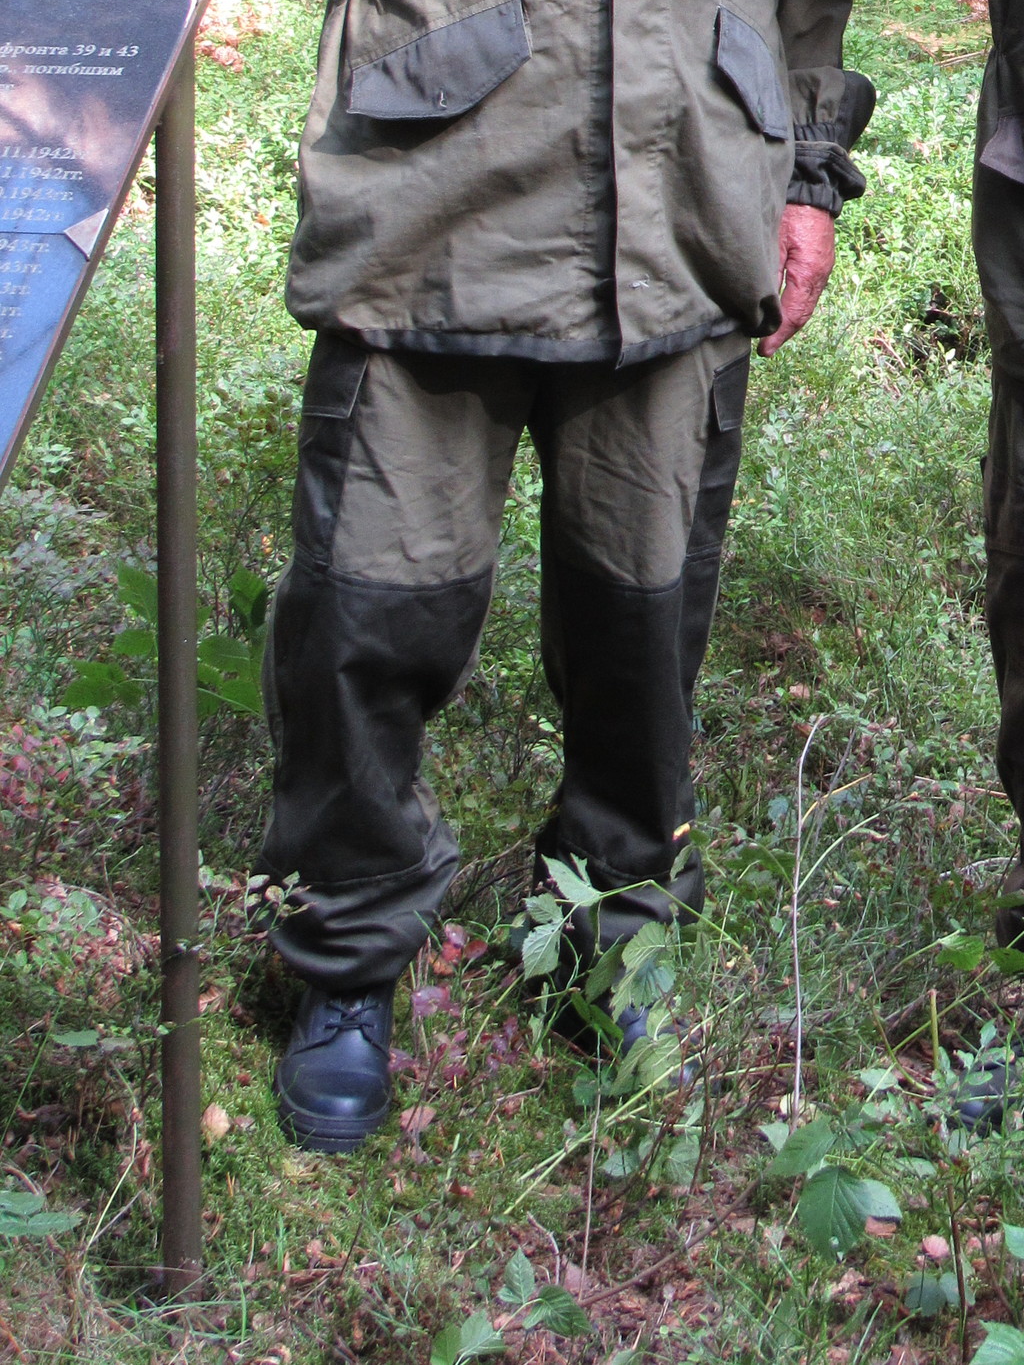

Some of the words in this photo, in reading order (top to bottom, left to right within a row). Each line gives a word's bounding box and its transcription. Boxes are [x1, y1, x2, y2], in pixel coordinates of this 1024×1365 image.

[0, 41, 69, 58] фронта
[72, 44, 97, 56] 39
[98, 47, 113, 57] и
[116, 44, 140, 57] 43
[22, 62, 125, 76] погибшим
